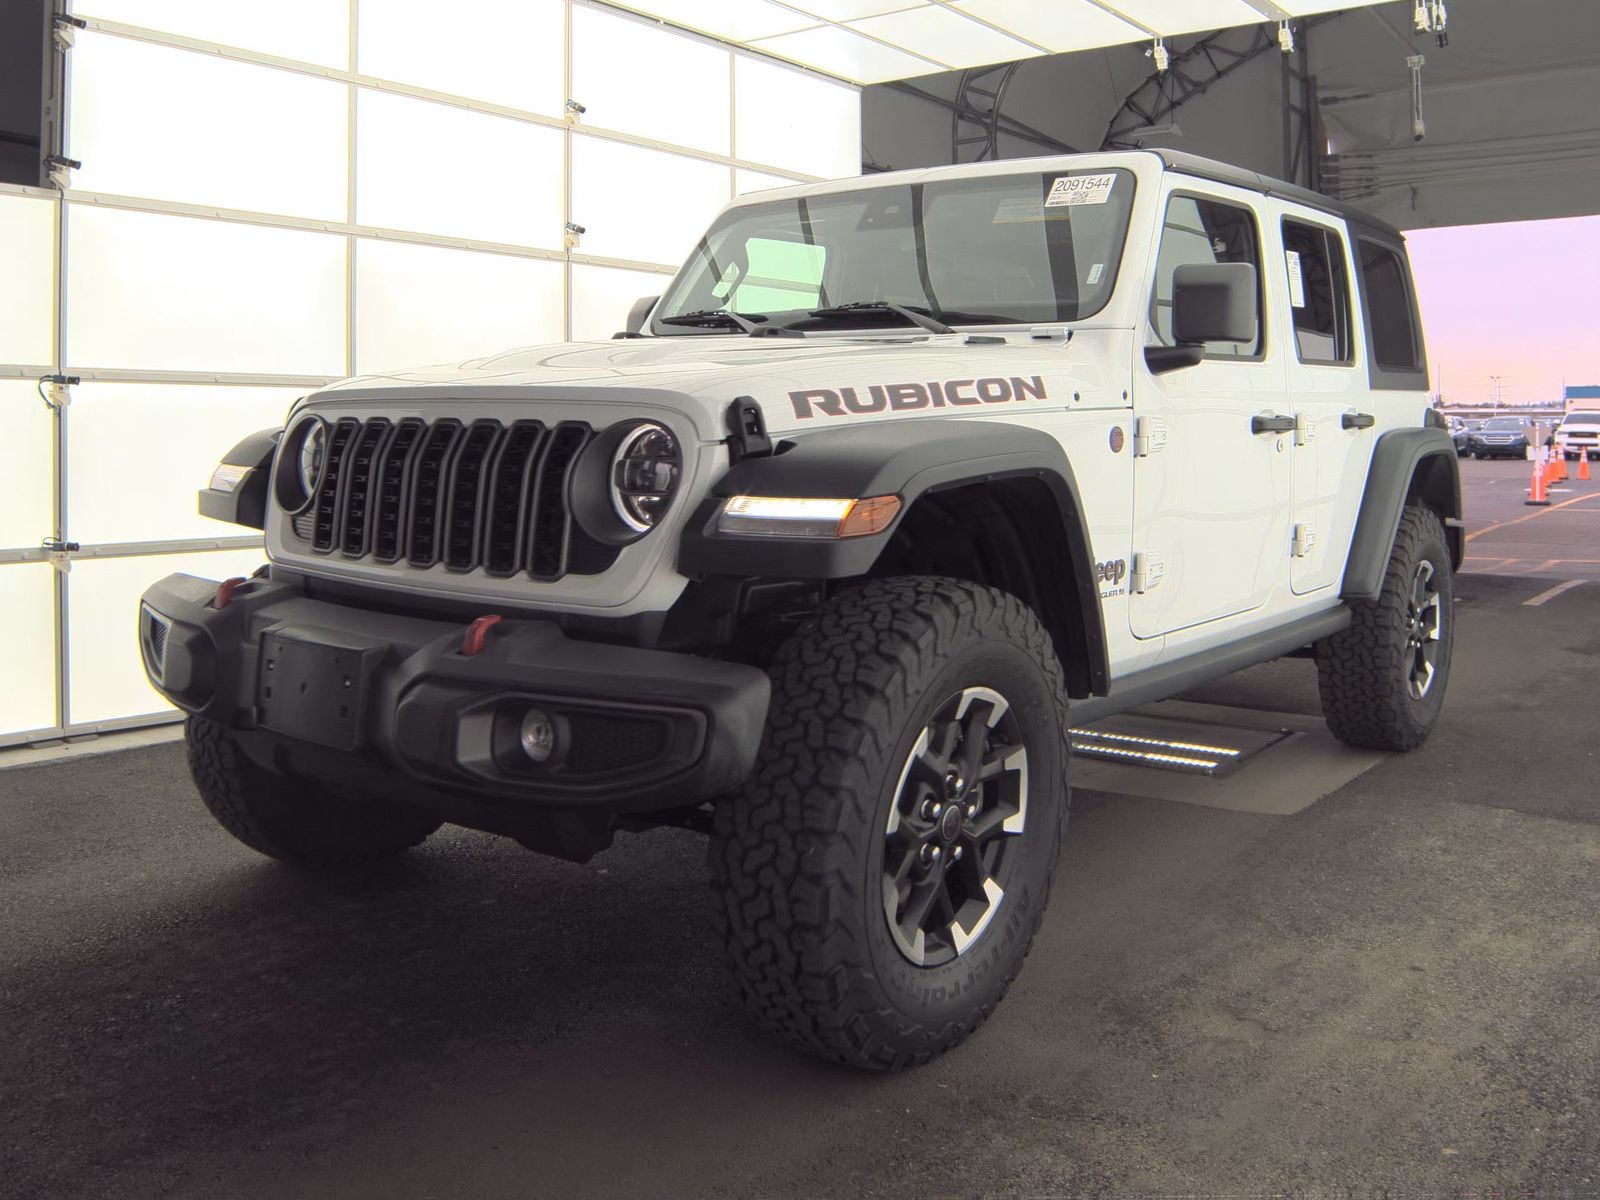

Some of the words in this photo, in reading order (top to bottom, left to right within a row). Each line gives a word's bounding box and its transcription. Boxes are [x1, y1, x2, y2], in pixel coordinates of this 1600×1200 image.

[1055, 178, 1111, 192] 2091544
[788, 375, 1047, 419] RUBICON
[1096, 559, 1125, 585] eep
